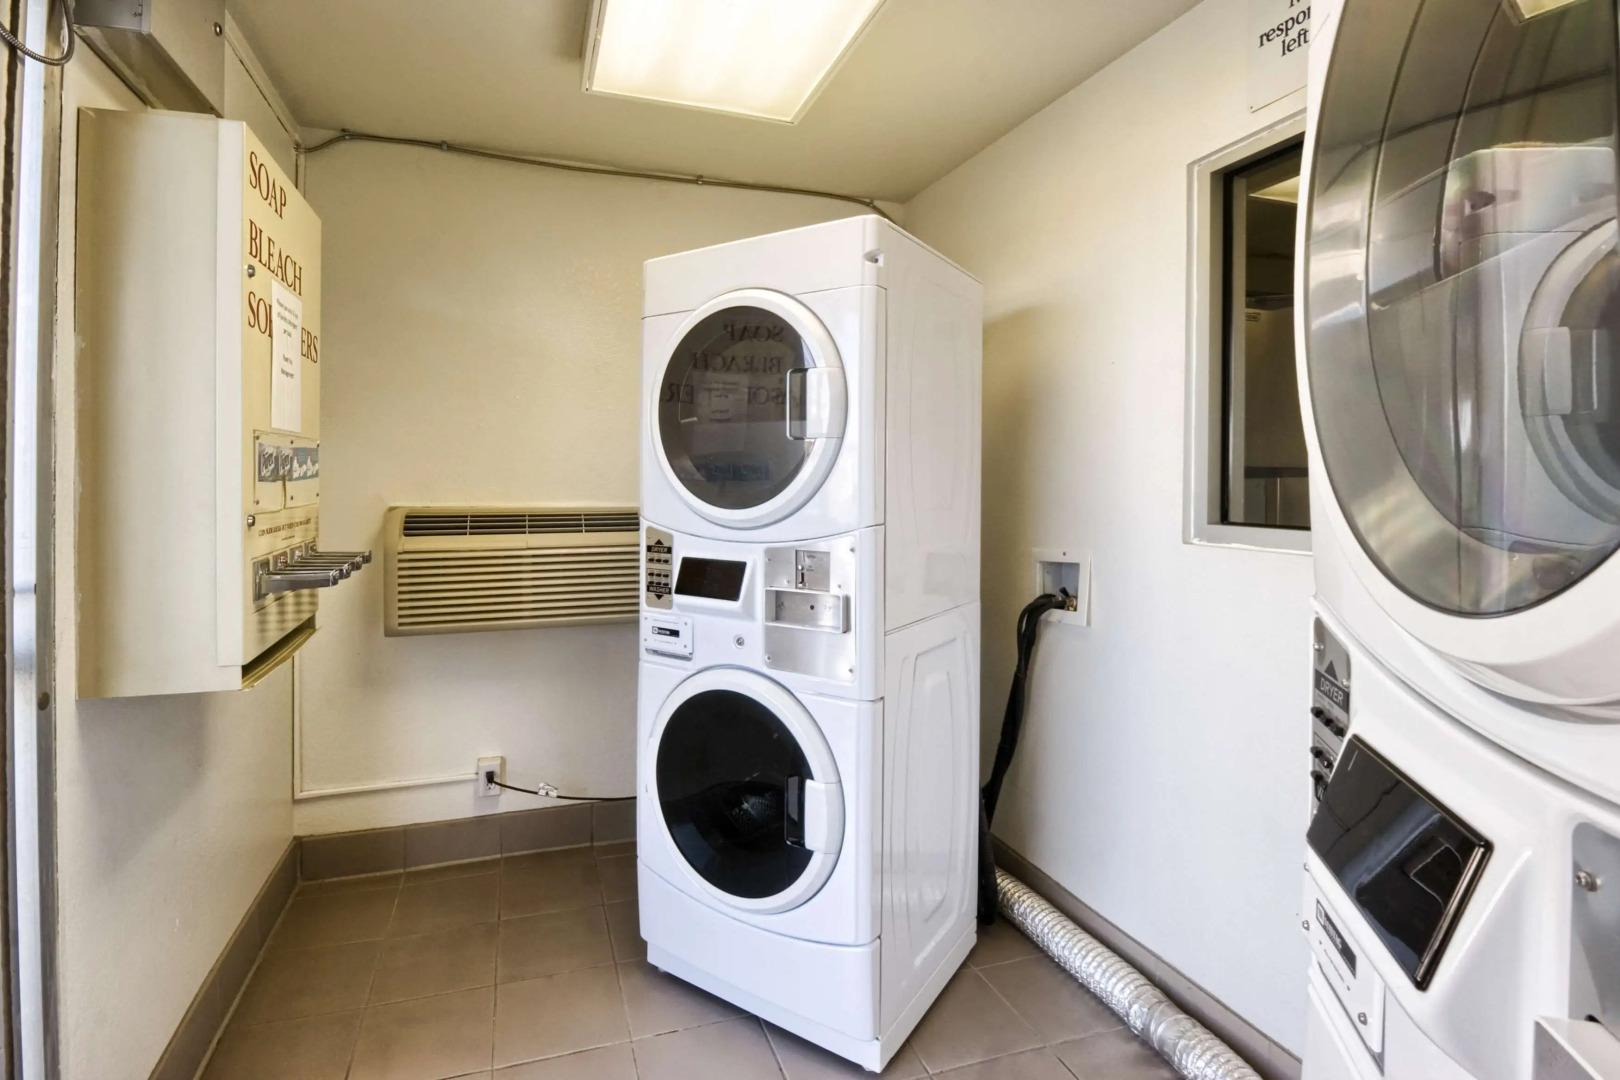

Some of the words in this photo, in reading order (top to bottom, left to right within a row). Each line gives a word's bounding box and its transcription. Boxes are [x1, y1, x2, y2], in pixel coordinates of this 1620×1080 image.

[1281, 28, 1309, 57] left
[249, 151, 287, 219] SOAP
[249, 218, 302, 296] BLEACH
[1320, 677, 1343, 706] DRYER
